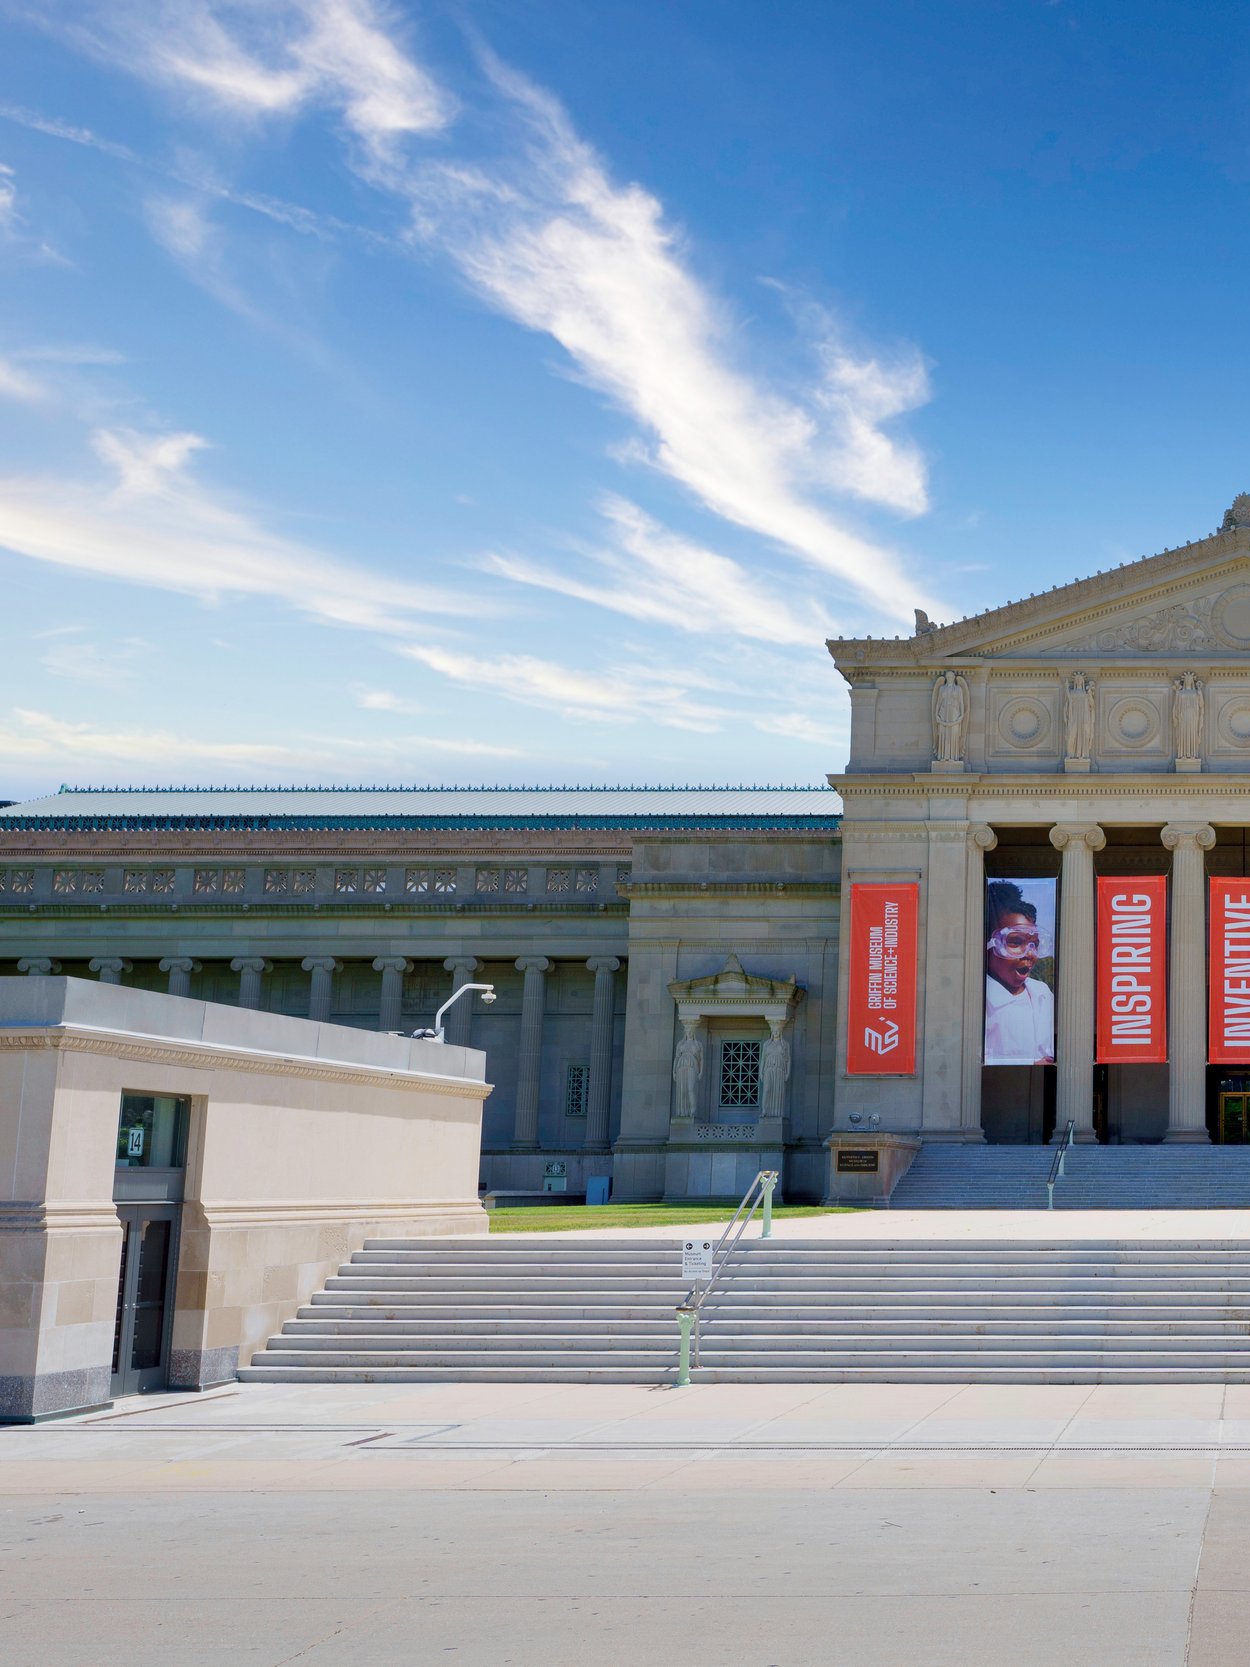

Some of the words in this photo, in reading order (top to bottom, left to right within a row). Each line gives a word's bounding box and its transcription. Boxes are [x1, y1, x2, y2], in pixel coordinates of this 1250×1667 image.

[869, 926, 883, 970] MUSEUM
[1111, 894, 1152, 1045] INSPIRING
[867, 973, 883, 1009] GRIFFIN
[883, 997, 897, 1009] OF
[130, 1132, 141, 1152] 14
